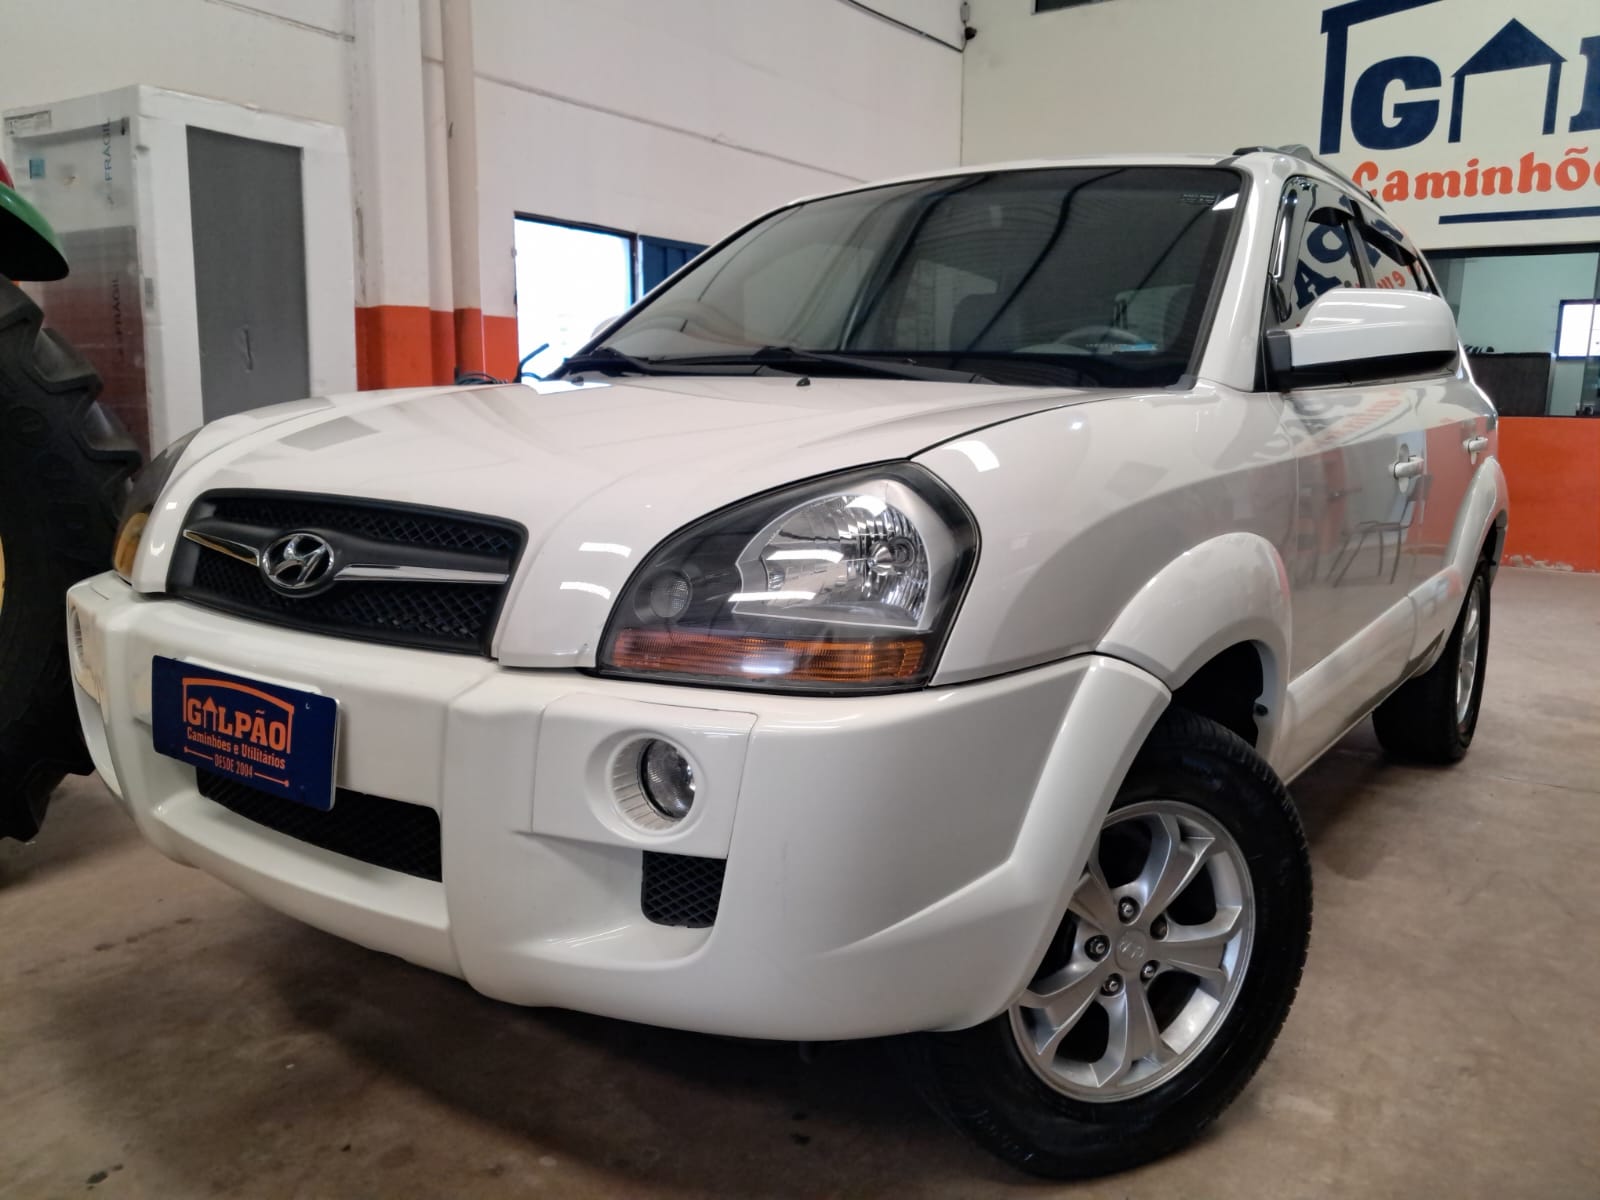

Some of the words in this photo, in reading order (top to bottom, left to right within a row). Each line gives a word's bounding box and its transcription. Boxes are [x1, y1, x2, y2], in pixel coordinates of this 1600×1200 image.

[186, 726, 232, 753] Caminhões
[233, 744, 239, 755] e
[241, 743, 286, 770] Utilitários
[214, 753, 235, 773] DESDE
[236, 761, 253, 778] 2004
